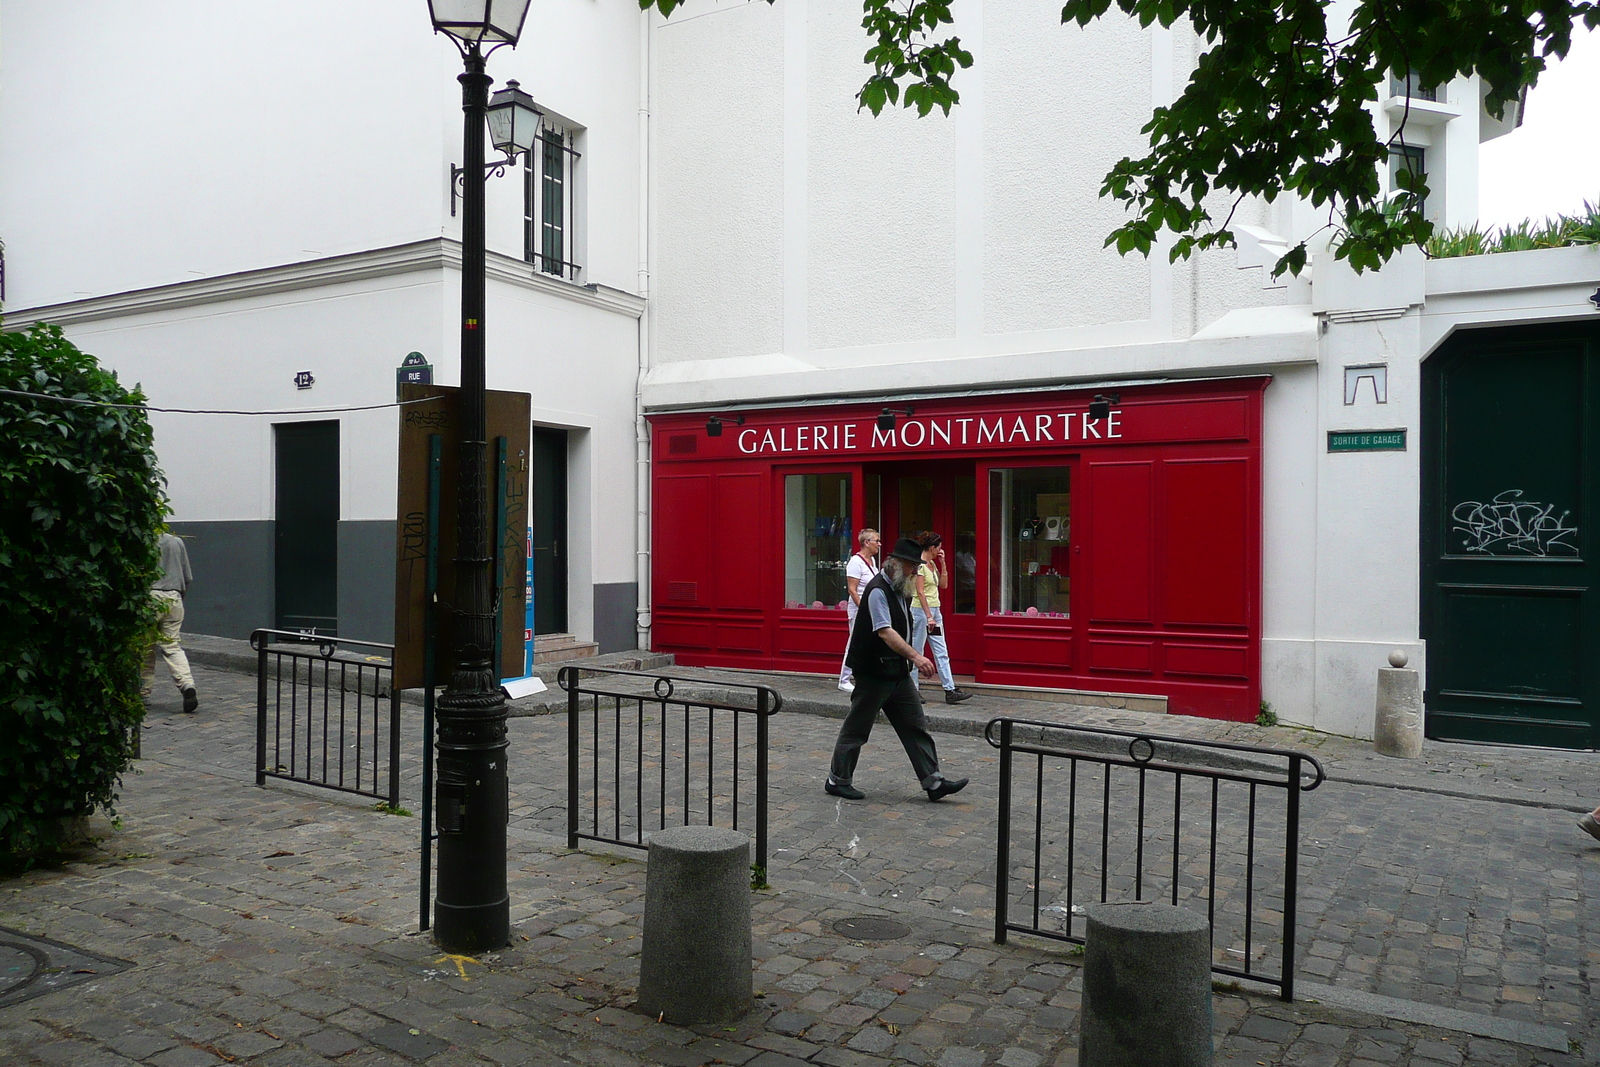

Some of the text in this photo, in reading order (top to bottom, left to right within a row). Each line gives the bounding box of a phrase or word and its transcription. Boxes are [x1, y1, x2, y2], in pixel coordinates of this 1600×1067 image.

[299, 374, 309, 385] 12
[408, 372, 421, 381] RUE
[738, 410, 1123, 454] GALERIE MONTMARTRE
[1333, 434, 1402, 446] SORTIE DE GARAGE
